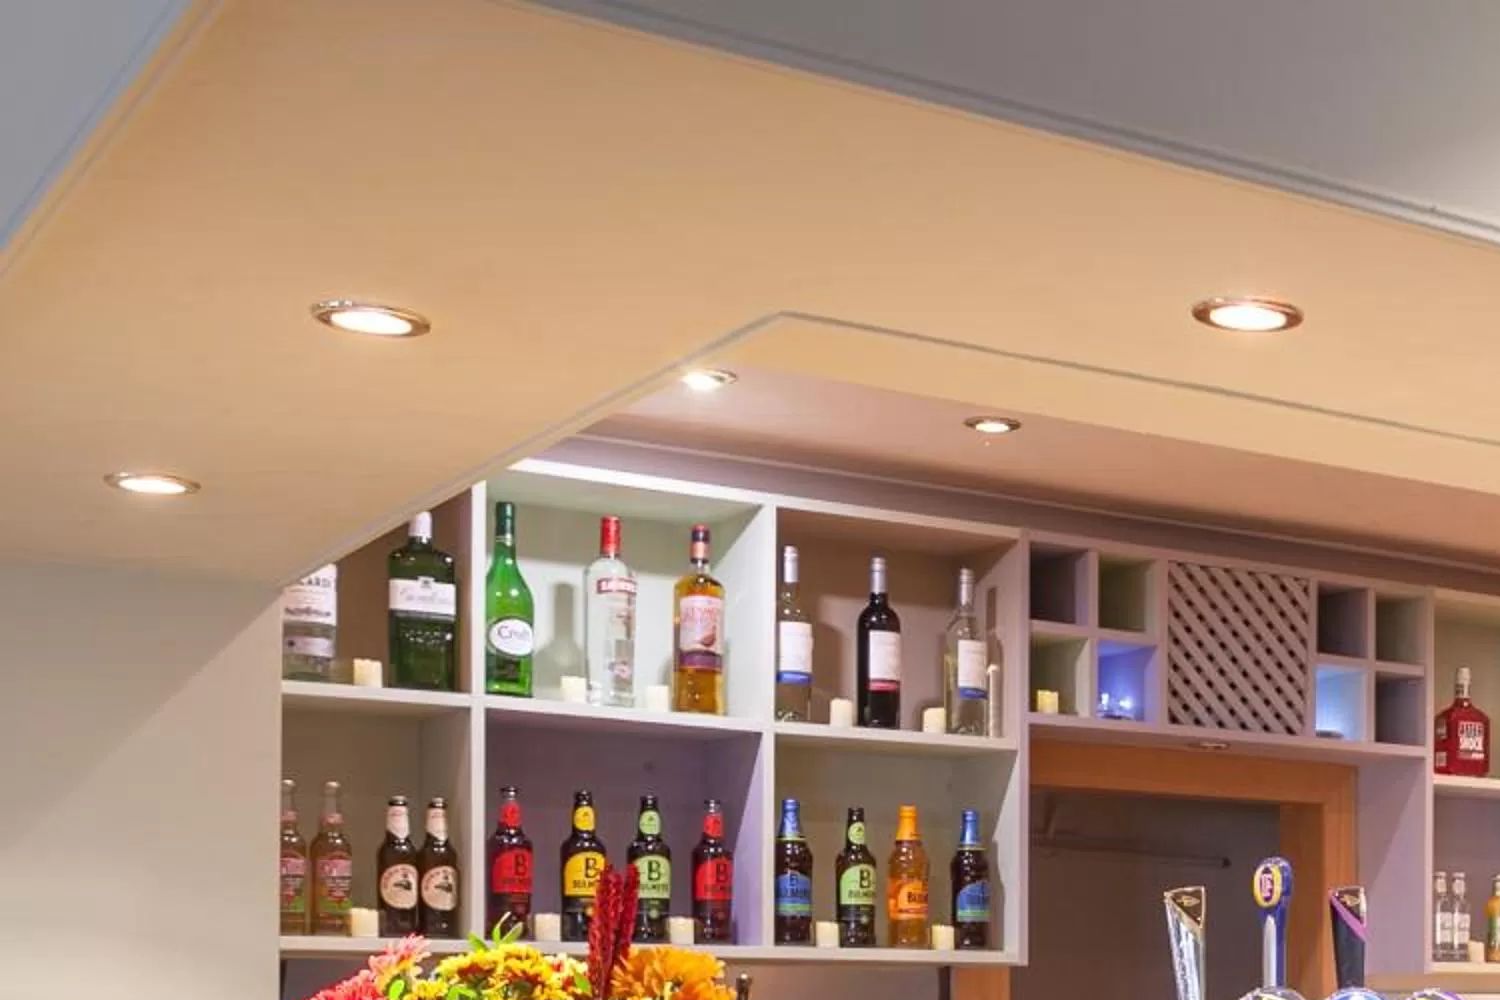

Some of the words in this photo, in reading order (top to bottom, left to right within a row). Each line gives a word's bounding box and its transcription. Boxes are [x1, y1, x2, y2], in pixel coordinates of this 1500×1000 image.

[515, 855, 526, 877] B
[585, 858, 598, 879] B
[648, 860, 660, 881] B
[716, 863, 728, 882] B
[859, 869, 871, 889] B
